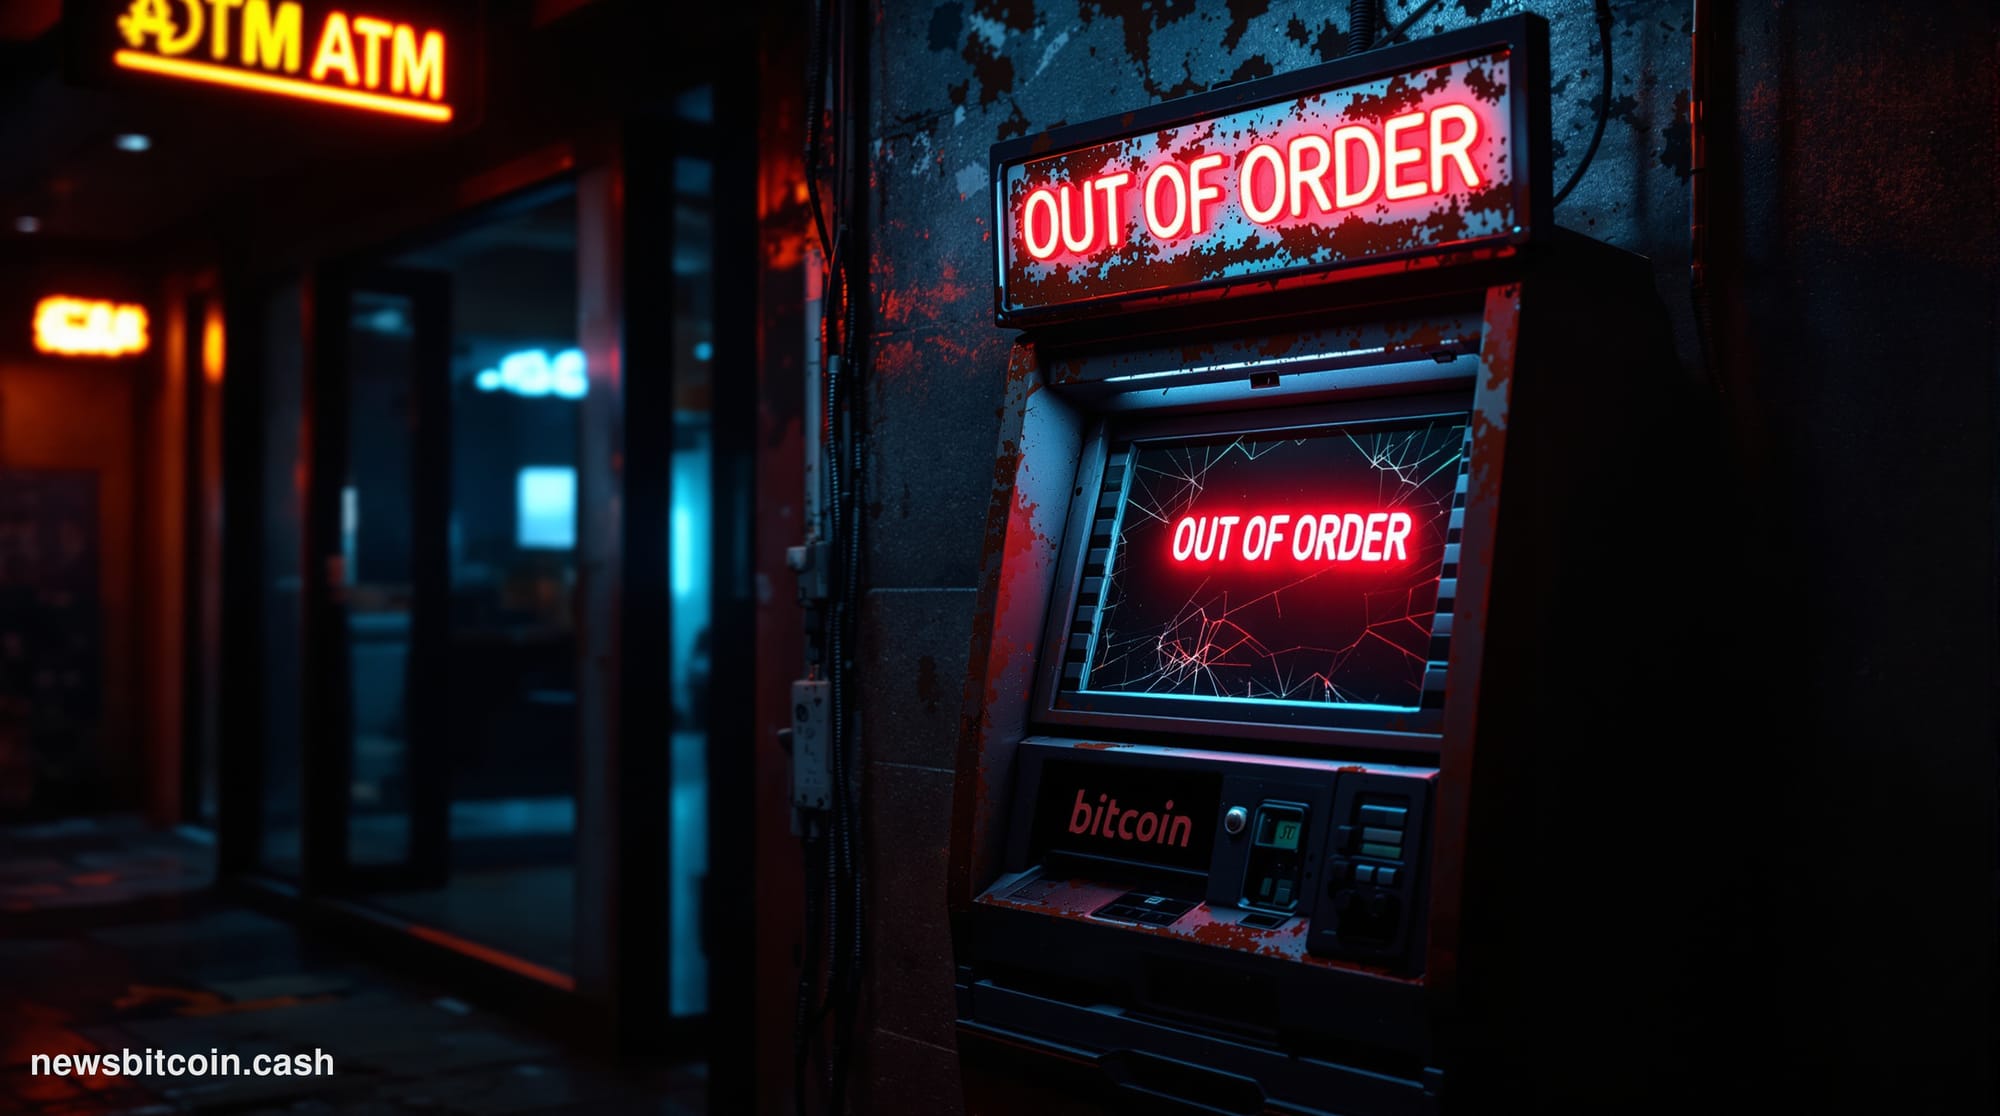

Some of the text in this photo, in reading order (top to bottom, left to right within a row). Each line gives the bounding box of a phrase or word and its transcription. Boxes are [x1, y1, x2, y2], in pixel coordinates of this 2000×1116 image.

[310, 11, 445, 100] ATM
[1023, 103, 1481, 260] OUT OF ORDER
[1172, 512, 1412, 562] OUT OF ORDER
[1068, 789, 1192, 848] bitcoin
